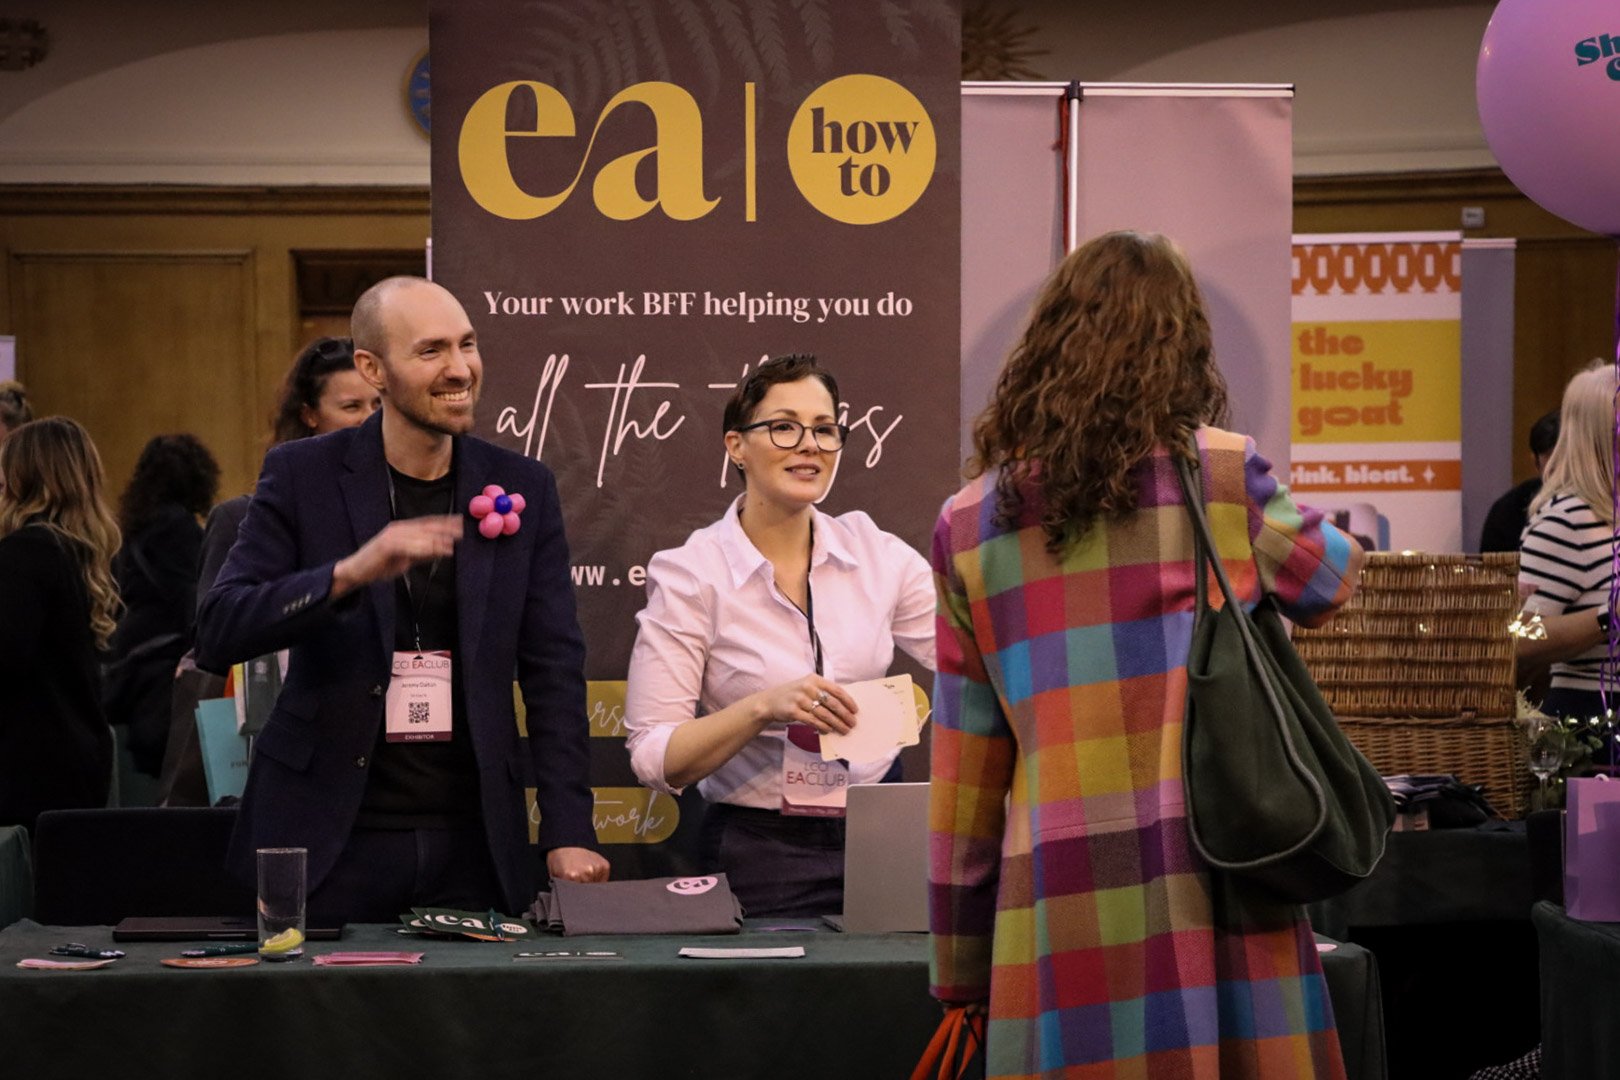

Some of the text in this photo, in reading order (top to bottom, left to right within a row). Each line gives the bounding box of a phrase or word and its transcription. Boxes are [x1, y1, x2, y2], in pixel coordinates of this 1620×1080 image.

[810, 106, 919, 155] how
[458, 80, 722, 221] ea
[838, 155, 891, 197] to
[484, 291, 914, 323] Your work BFF helping you do
[1298, 327, 1365, 355] the
[1300, 361, 1414, 398] lucky
[496, 354, 570, 461] all
[584, 354, 685, 488] the
[1298, 400, 1404, 436] goat
[412, 660, 450, 670] EACLUB
[786, 769, 846, 787] EACLUB
